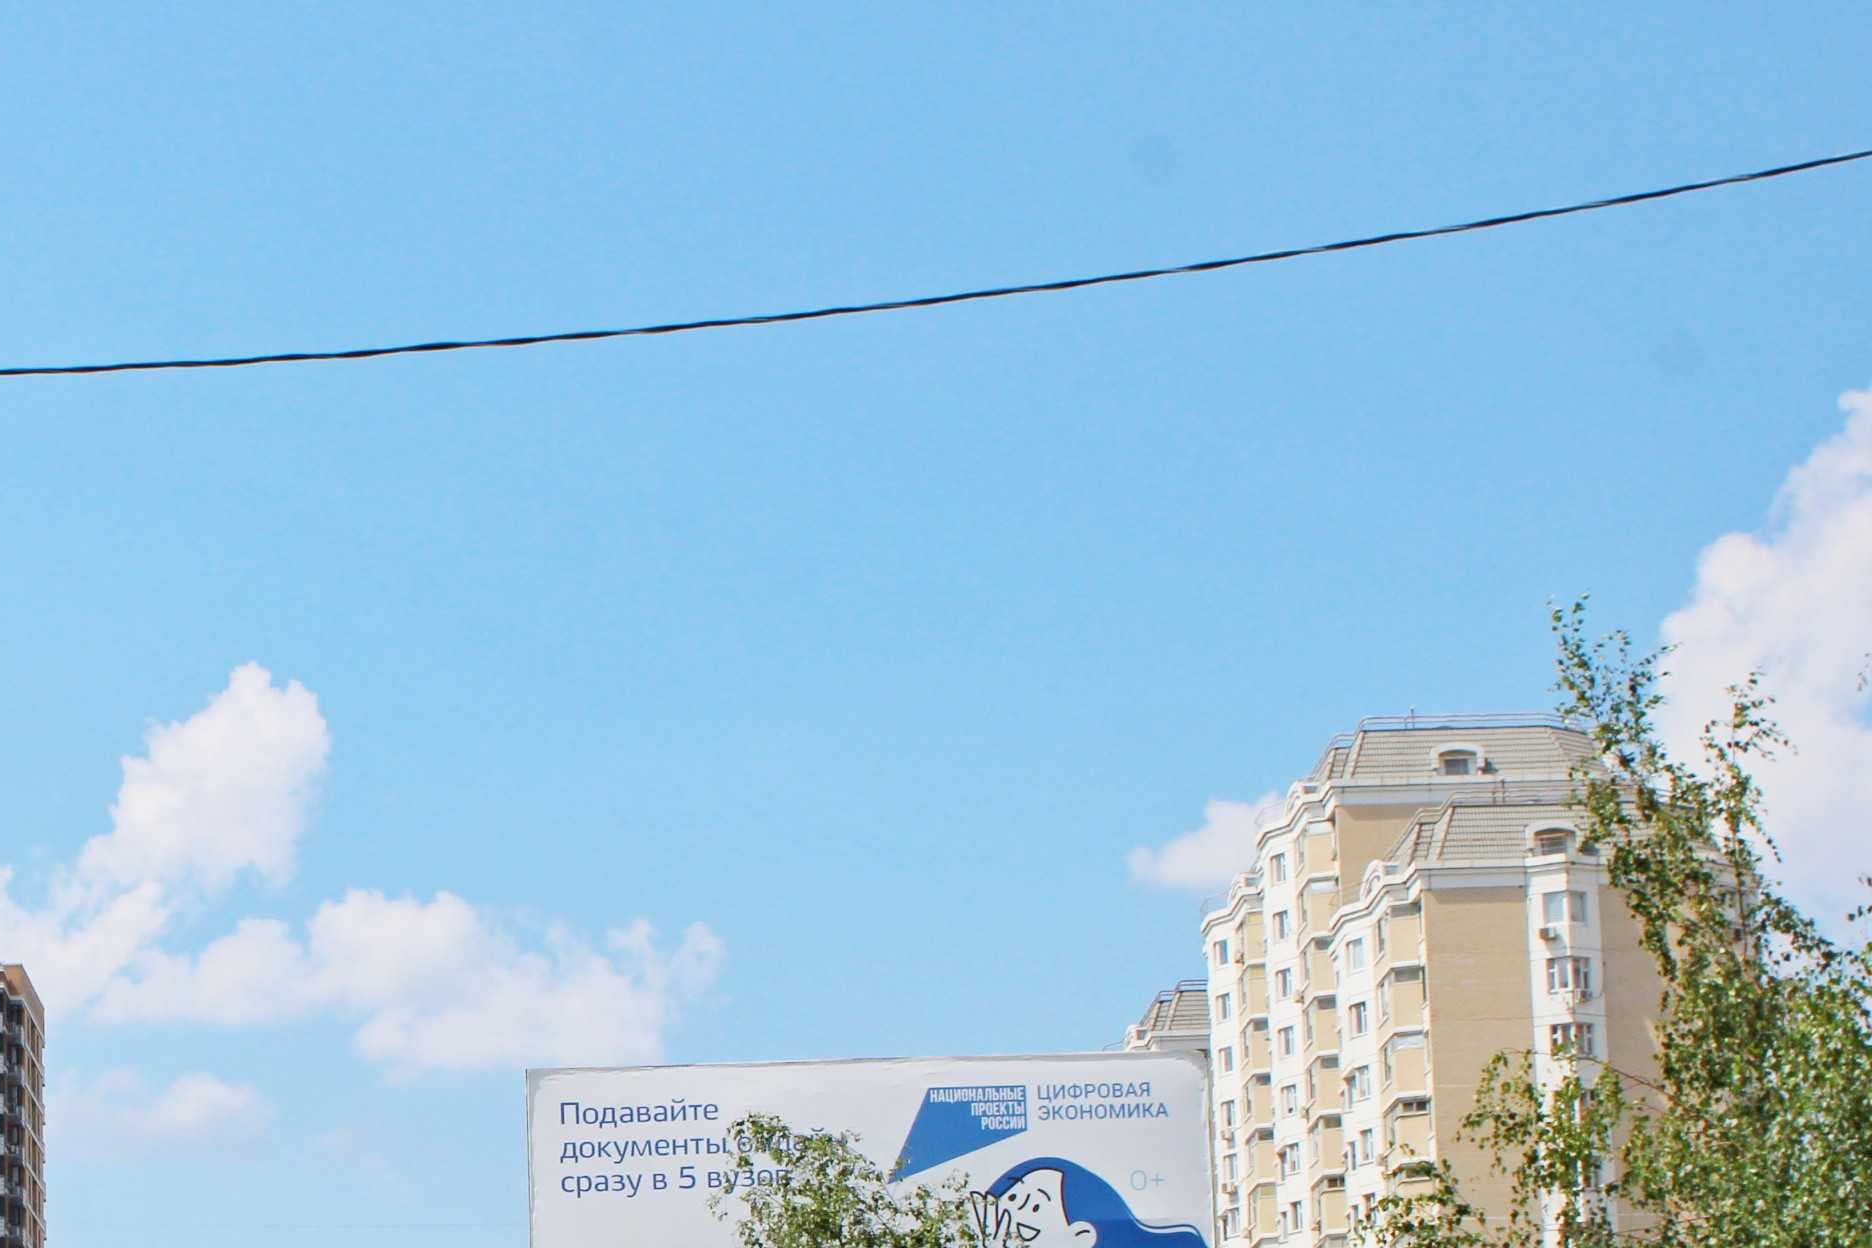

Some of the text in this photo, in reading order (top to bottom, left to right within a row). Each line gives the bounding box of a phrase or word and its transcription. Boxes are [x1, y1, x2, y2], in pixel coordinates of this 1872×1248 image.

[929, 1087, 1025, 1103] НАЦИОНАЛЬНЫЕ
[1037, 1081, 1151, 1101] ЦИФРОВАЯ
[559, 1098, 719, 1128] Подавайте
[970, 1101, 1025, 1117] ПРОЕКТЫ
[1037, 1102, 1169, 1121] ЭКОНОМИКА
[980, 1114, 1026, 1131] РОССИИ
[559, 1135, 728, 1164] документы
[560, 1172, 643, 1199] сразу
[651, 1172, 668, 1190] в
[678, 1166, 697, 1189] 5
[1130, 1169, 1165, 1192] 0+
